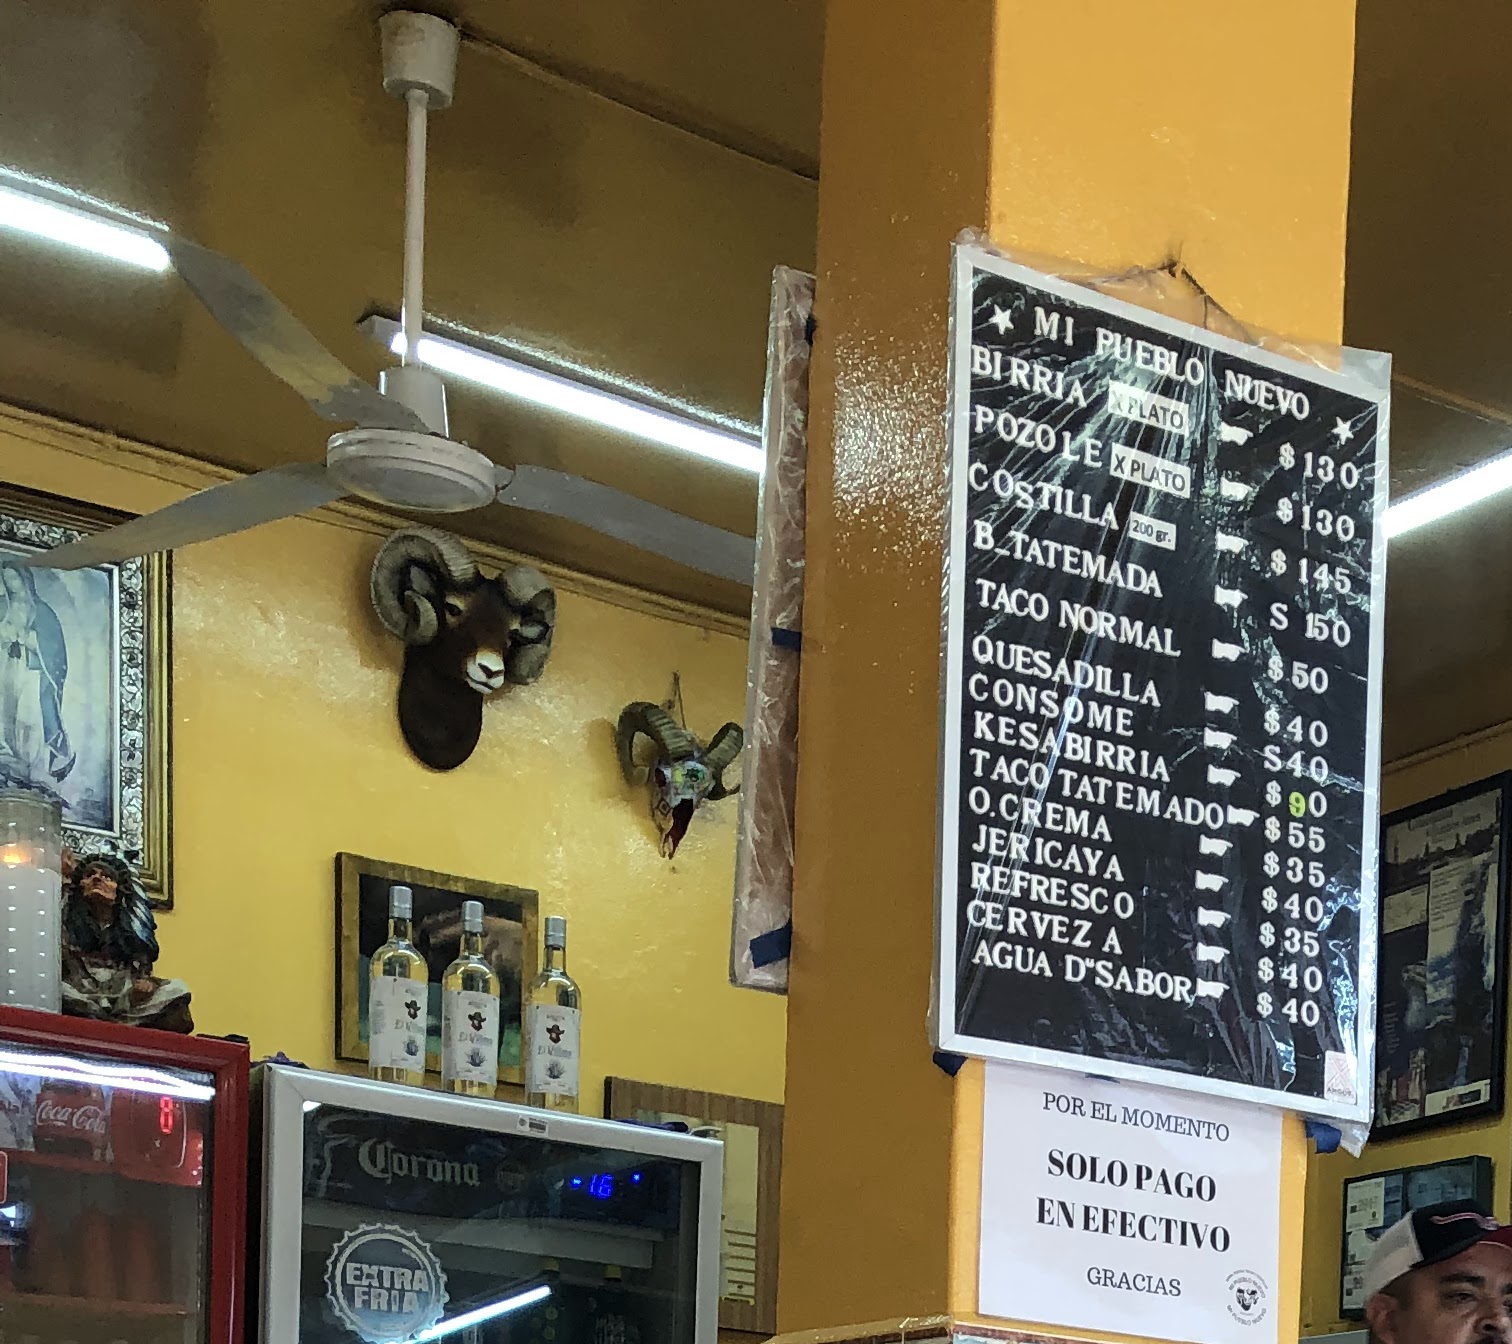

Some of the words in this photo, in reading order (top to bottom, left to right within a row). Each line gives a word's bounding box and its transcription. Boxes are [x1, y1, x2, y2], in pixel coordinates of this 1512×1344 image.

[971, 345, 1087, 408] BIRRIA
[1034, 306, 1074, 346] MI
[1096, 327, 1204, 386] PUEBLO
[1225, 369, 1310, 420] NUEVO
[975, 404, 1102, 467] POZOLE
[1113, 456, 1125, 474] X
[1130, 462, 1185, 492] PLATO
[968, 462, 1119, 530] COSTILLA
[1132, 520, 1154, 537] 200
[976, 578, 1049, 618] TACO
[1059, 601, 1181, 657] NORMAL
[972, 635, 1160, 706] QUESADILLA
[968, 672, 1134, 736] CONSOME
[973, 711, 1170, 782] KESABIRRIA
[969, 749, 1048, 788] TACO
[1059, 768, 1225, 828] TATEMADO
[972, 825, 1124, 881] JERICAYA
[971, 862, 1135, 918] REFRESCO
[966, 900, 1123, 954] CERVEZA
[972, 940, 1053, 977] AGUA
[1043, 1092, 1086, 1117] POR
[1090, 1101, 1117, 1122] EL
[1121, 1107, 1230, 1142] MOMENTO
[358, 1138, 481, 1187] Corona
[1048, 1149, 1128, 1187] SOLO
[1134, 1163, 1217, 1202] PAGO
[1036, 1197, 1076, 1228] EN
[1082, 1205, 1230, 1252] EFECTIVO
[346, 1262, 429, 1292] EXTRA
[354, 1287, 420, 1314] FRIA
[1087, 1266, 1181, 1297] GRACIAS
